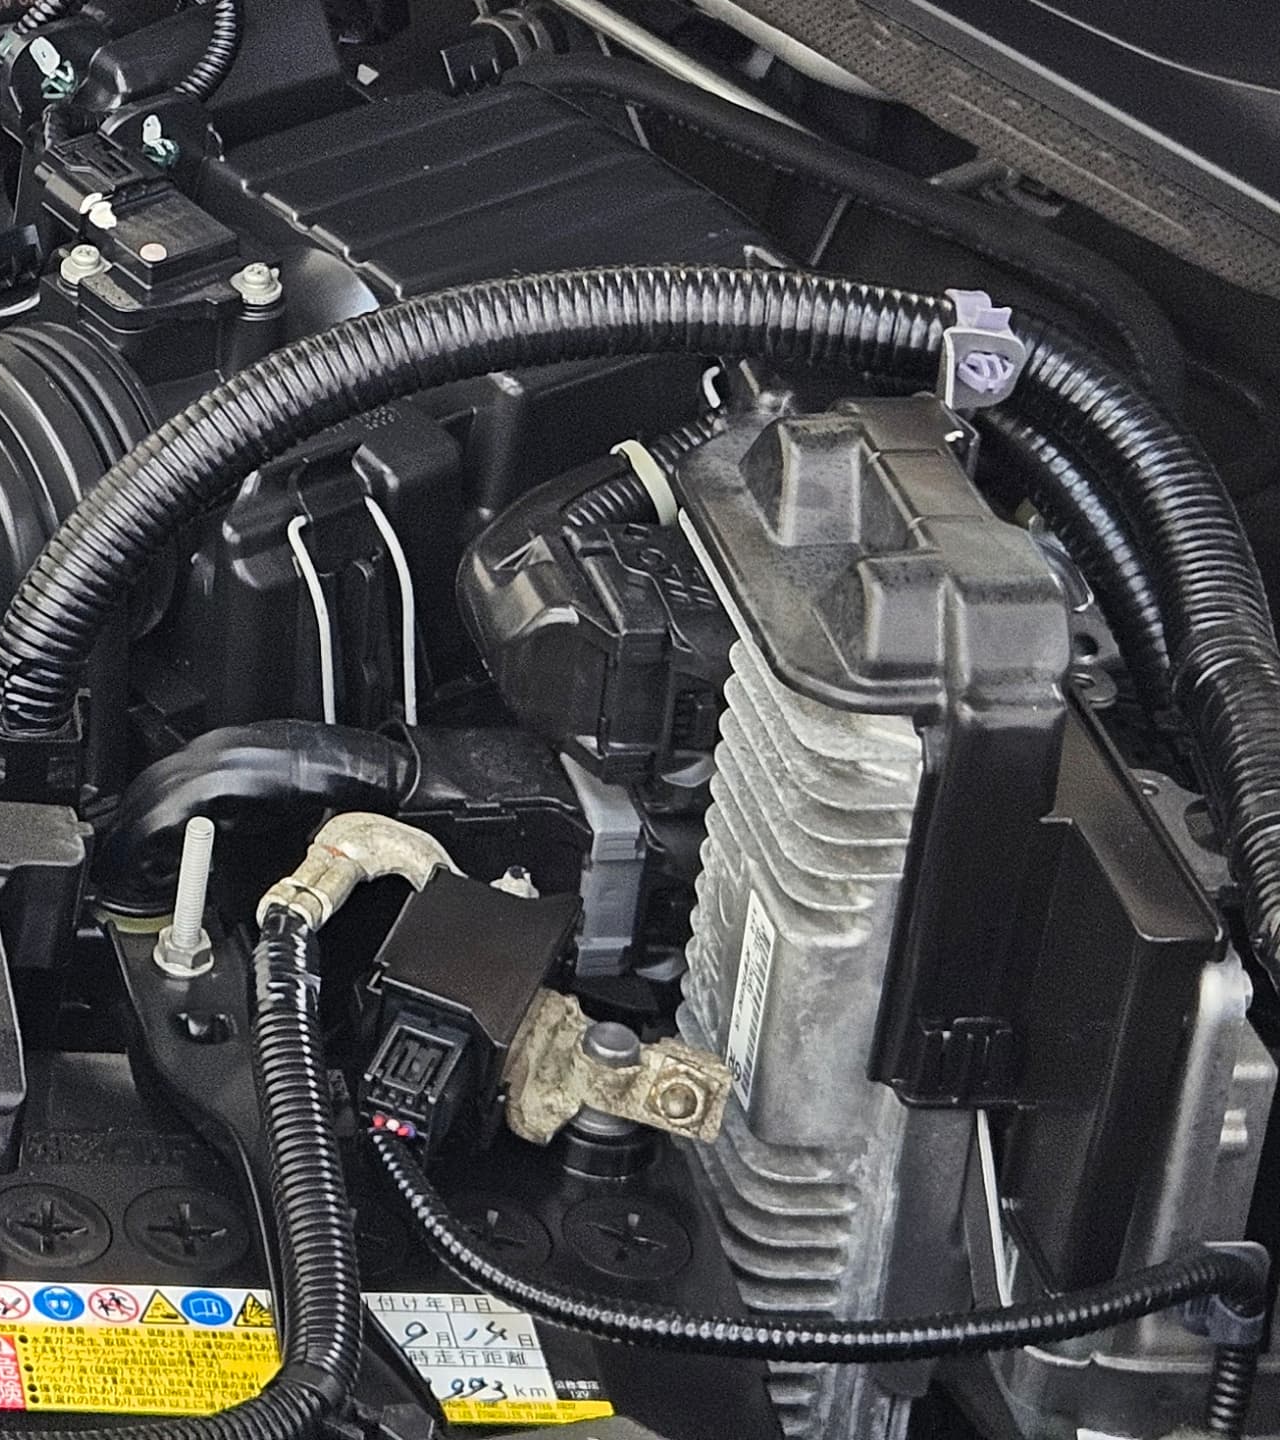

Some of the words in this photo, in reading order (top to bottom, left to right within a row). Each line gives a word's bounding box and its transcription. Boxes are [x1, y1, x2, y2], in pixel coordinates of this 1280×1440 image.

[365, 1294, 491, 1312] 付け年月日
[437, 1331, 453, 1347] 月
[518, 1333, 536, 1348] 日
[515, 1385, 548, 1398] km
